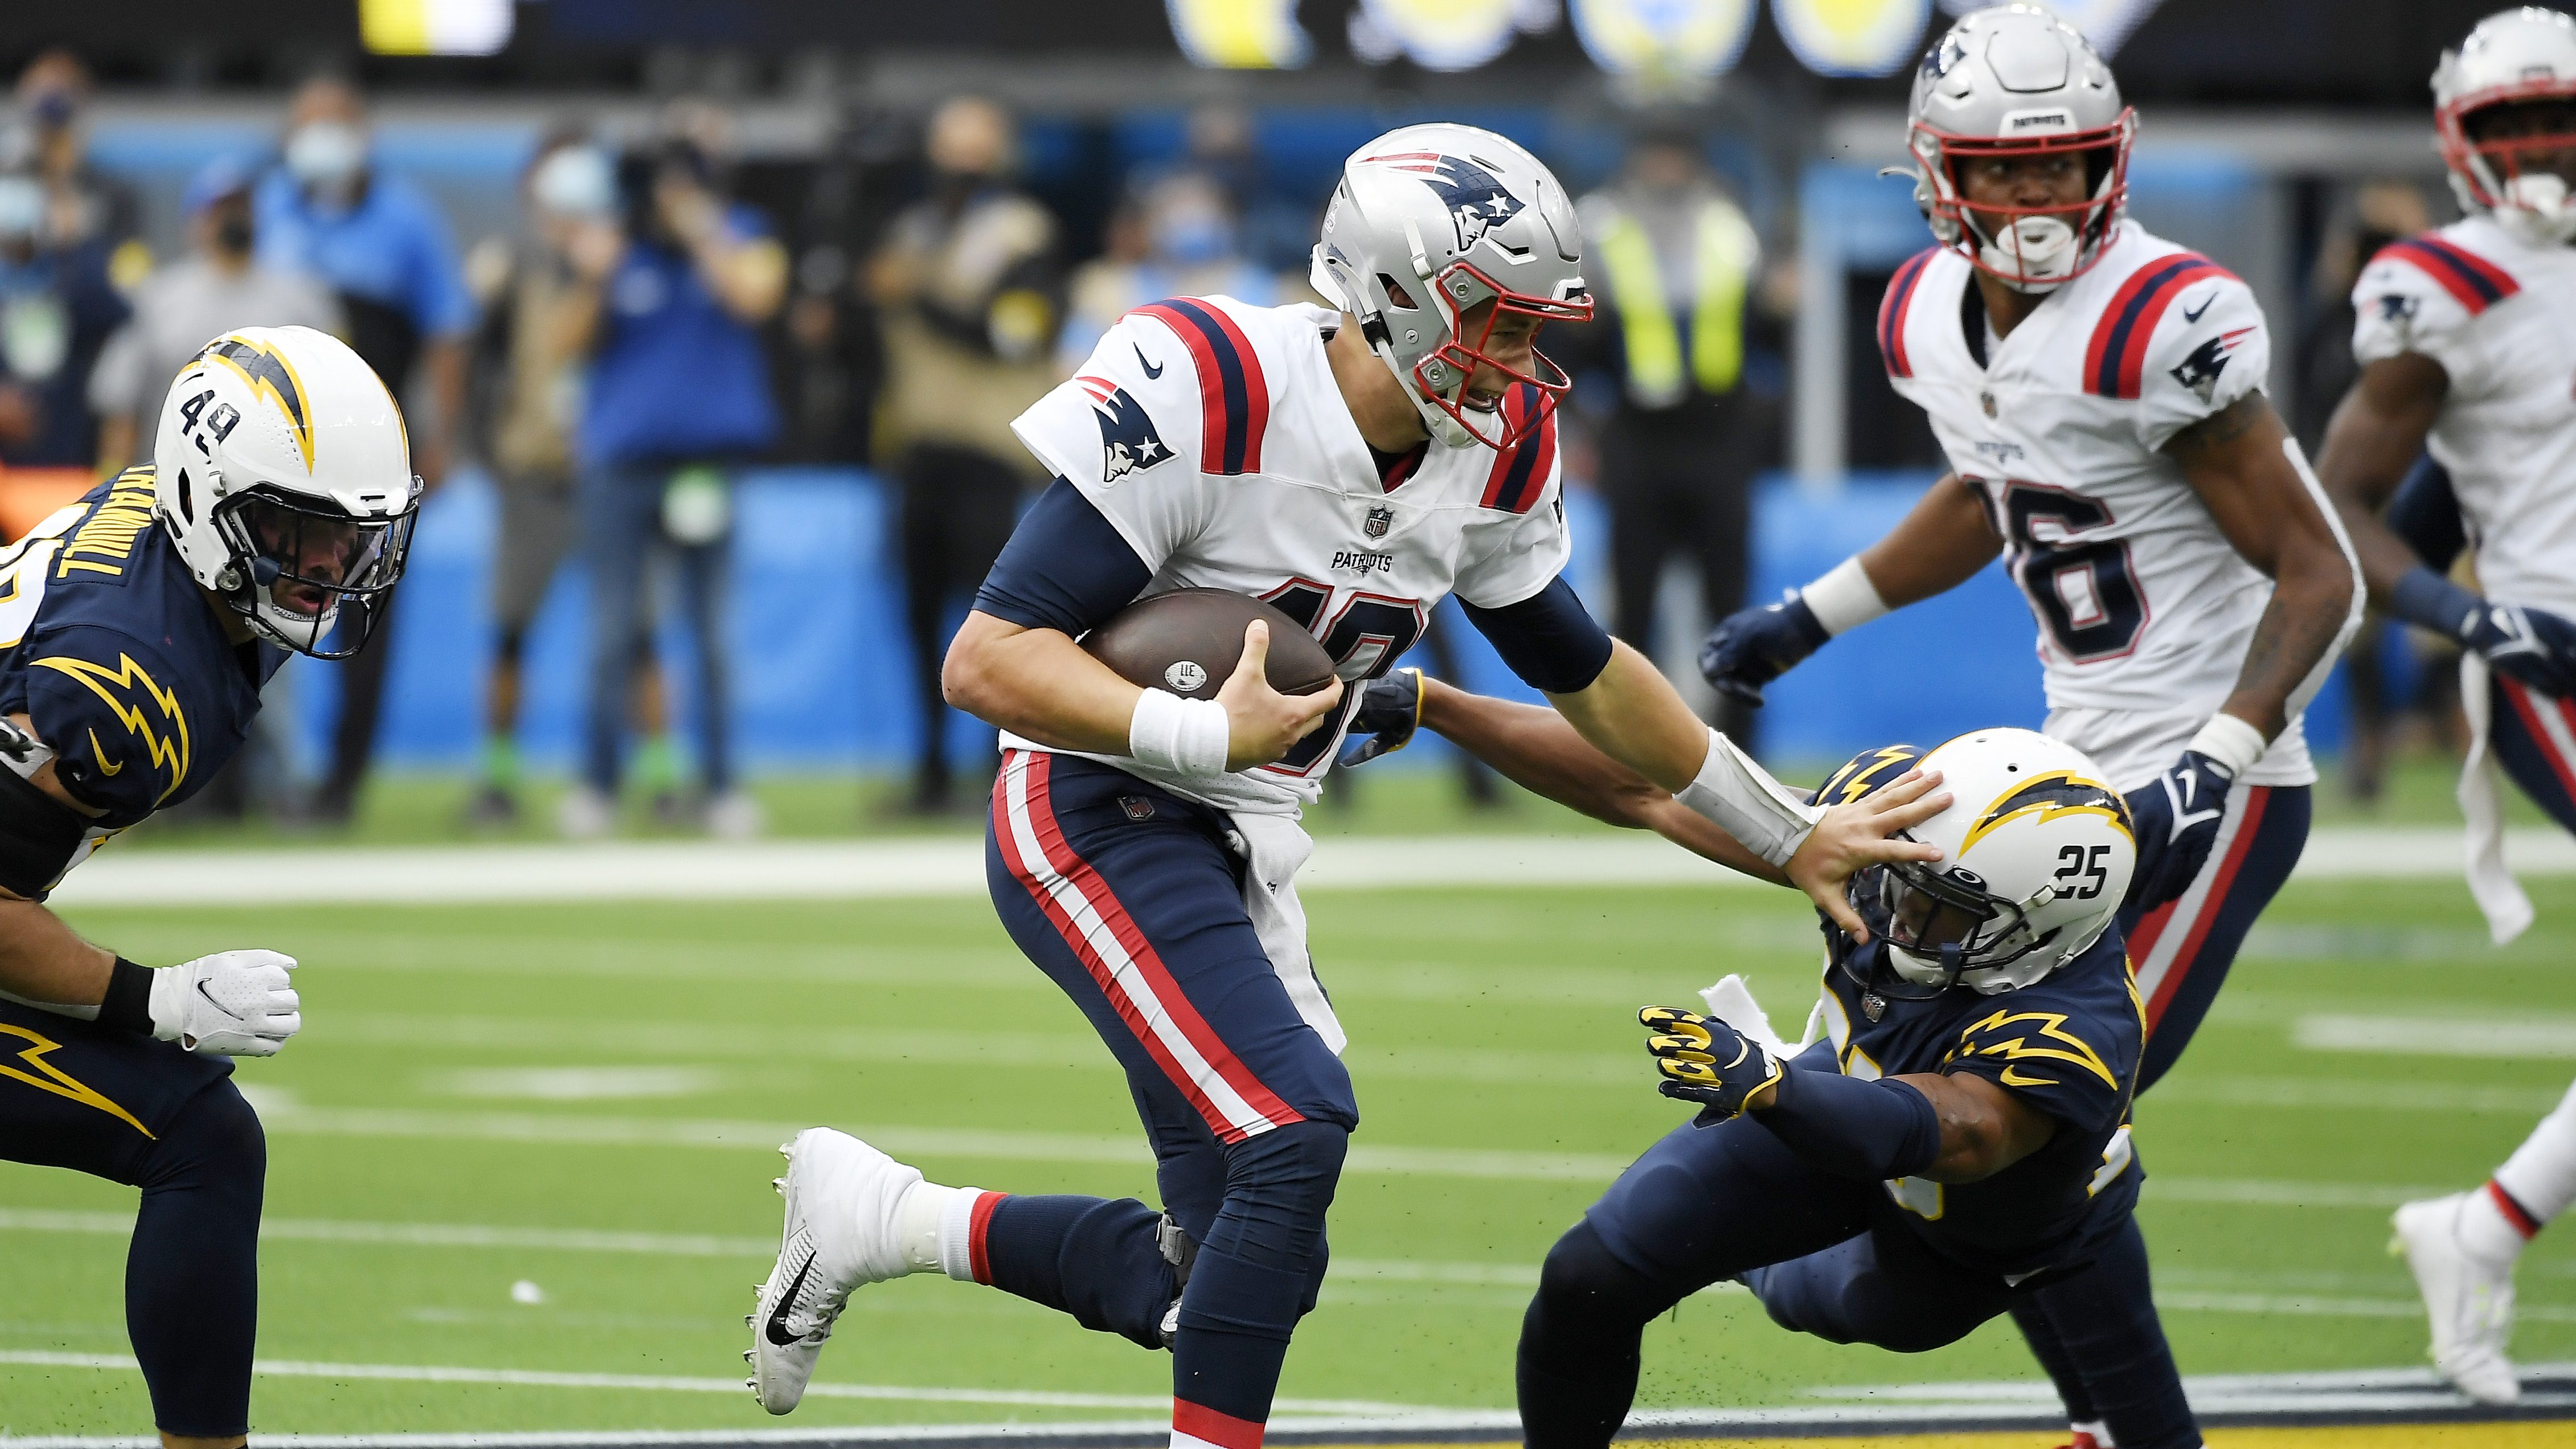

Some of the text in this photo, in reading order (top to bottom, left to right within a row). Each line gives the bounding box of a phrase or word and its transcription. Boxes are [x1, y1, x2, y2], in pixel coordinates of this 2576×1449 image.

[180, 390, 241, 465] 49
[1367, 519, 1386, 535] NFL
[1330, 551, 1393, 572] PATRIOTS
[2053, 845, 2111, 900] 25
